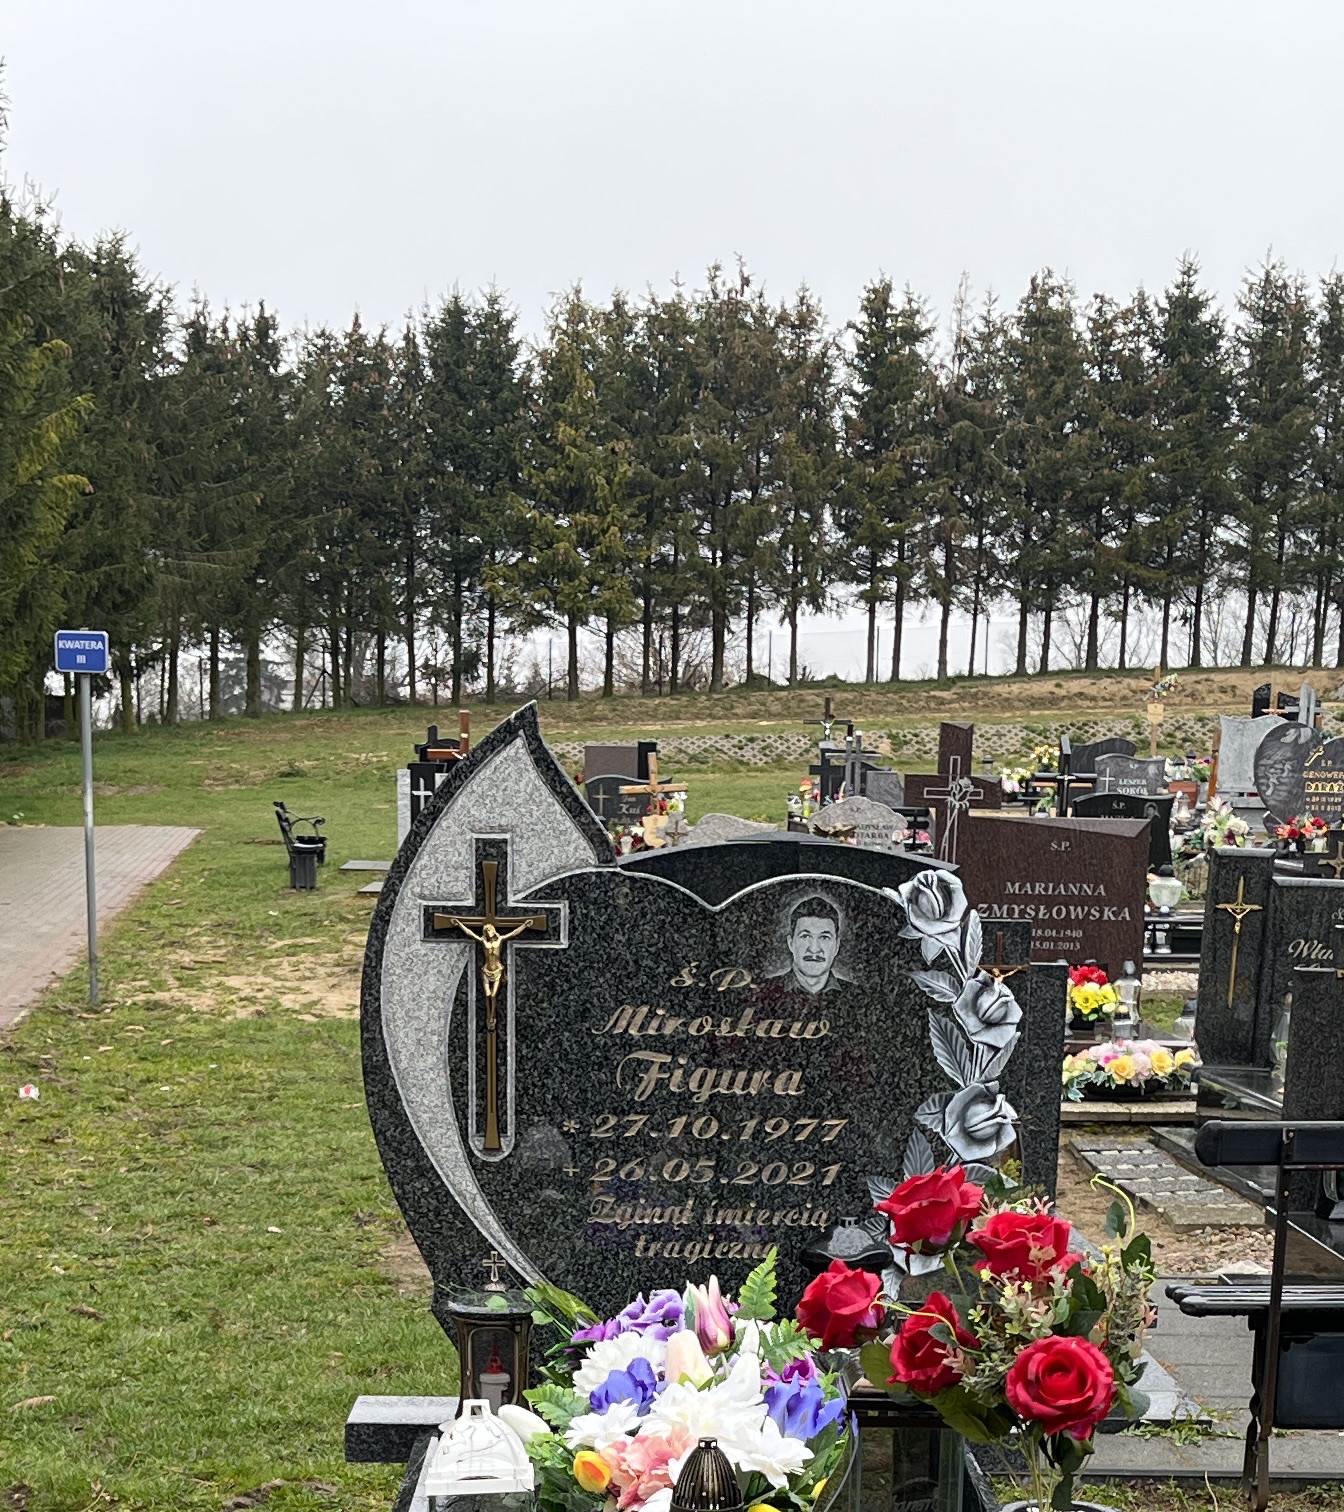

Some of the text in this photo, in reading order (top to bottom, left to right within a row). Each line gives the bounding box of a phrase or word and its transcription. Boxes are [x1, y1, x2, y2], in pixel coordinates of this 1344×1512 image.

[58, 640, 104, 650] KWATERA
[1005, 881, 1106, 896] MARIANNA
[977, 903, 1132, 922] ZMYSŁOWSKA
[591, 1004, 832, 1039] Mirosław
[616, 1050, 806, 1103] Figura
[590, 1114, 849, 1142] 27.10.1977
[589, 1157, 843, 1186] 26.05.2021
[586, 1196, 829, 1232] Zginął śmiercią
